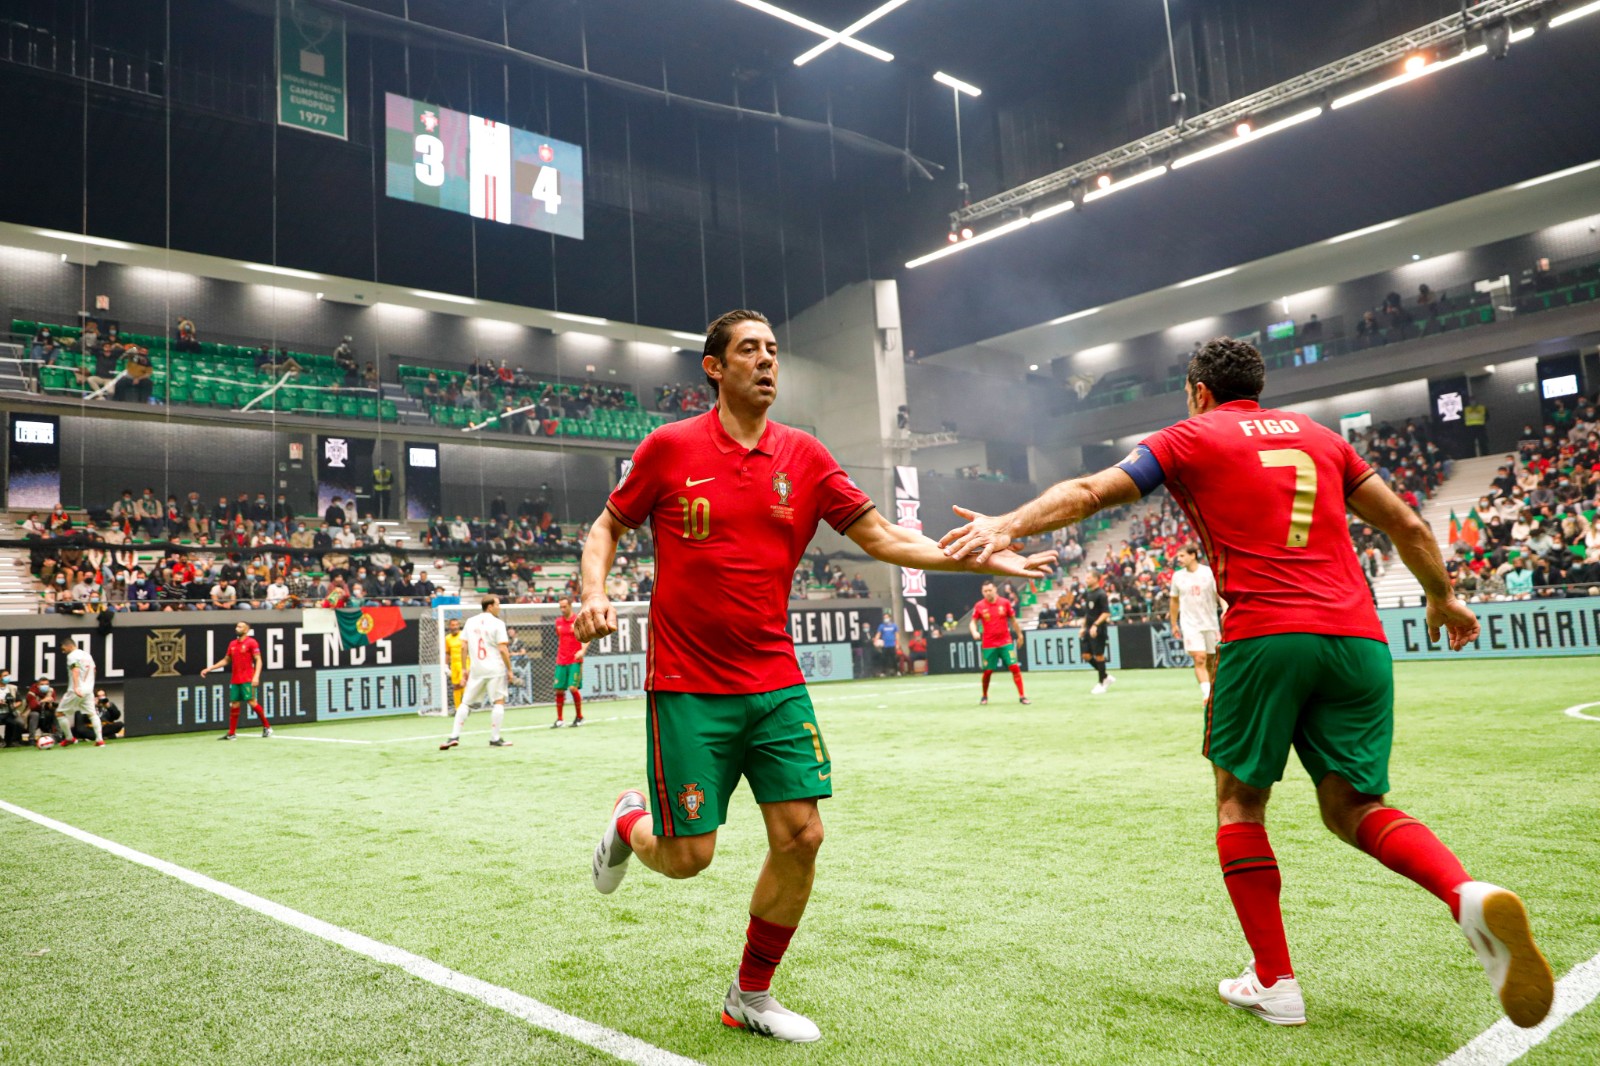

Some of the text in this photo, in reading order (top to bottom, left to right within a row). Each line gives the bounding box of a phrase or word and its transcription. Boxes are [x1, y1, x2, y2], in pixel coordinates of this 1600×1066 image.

[289, 84, 336, 103] CAMPEÕES
[290, 94, 336, 114] EUROPEUS
[299, 109, 328, 126] 1977
[415, 134, 445, 187] 3
[532, 165, 561, 214] 4
[1238, 418, 1300, 437] FIGO
[1257, 448, 1318, 548] 7
[677, 496, 711, 540] 10
[477, 638, 487, 661] 6
[592, 661, 641, 693] JOGO
[327, 673, 433, 714] LEGENDS
